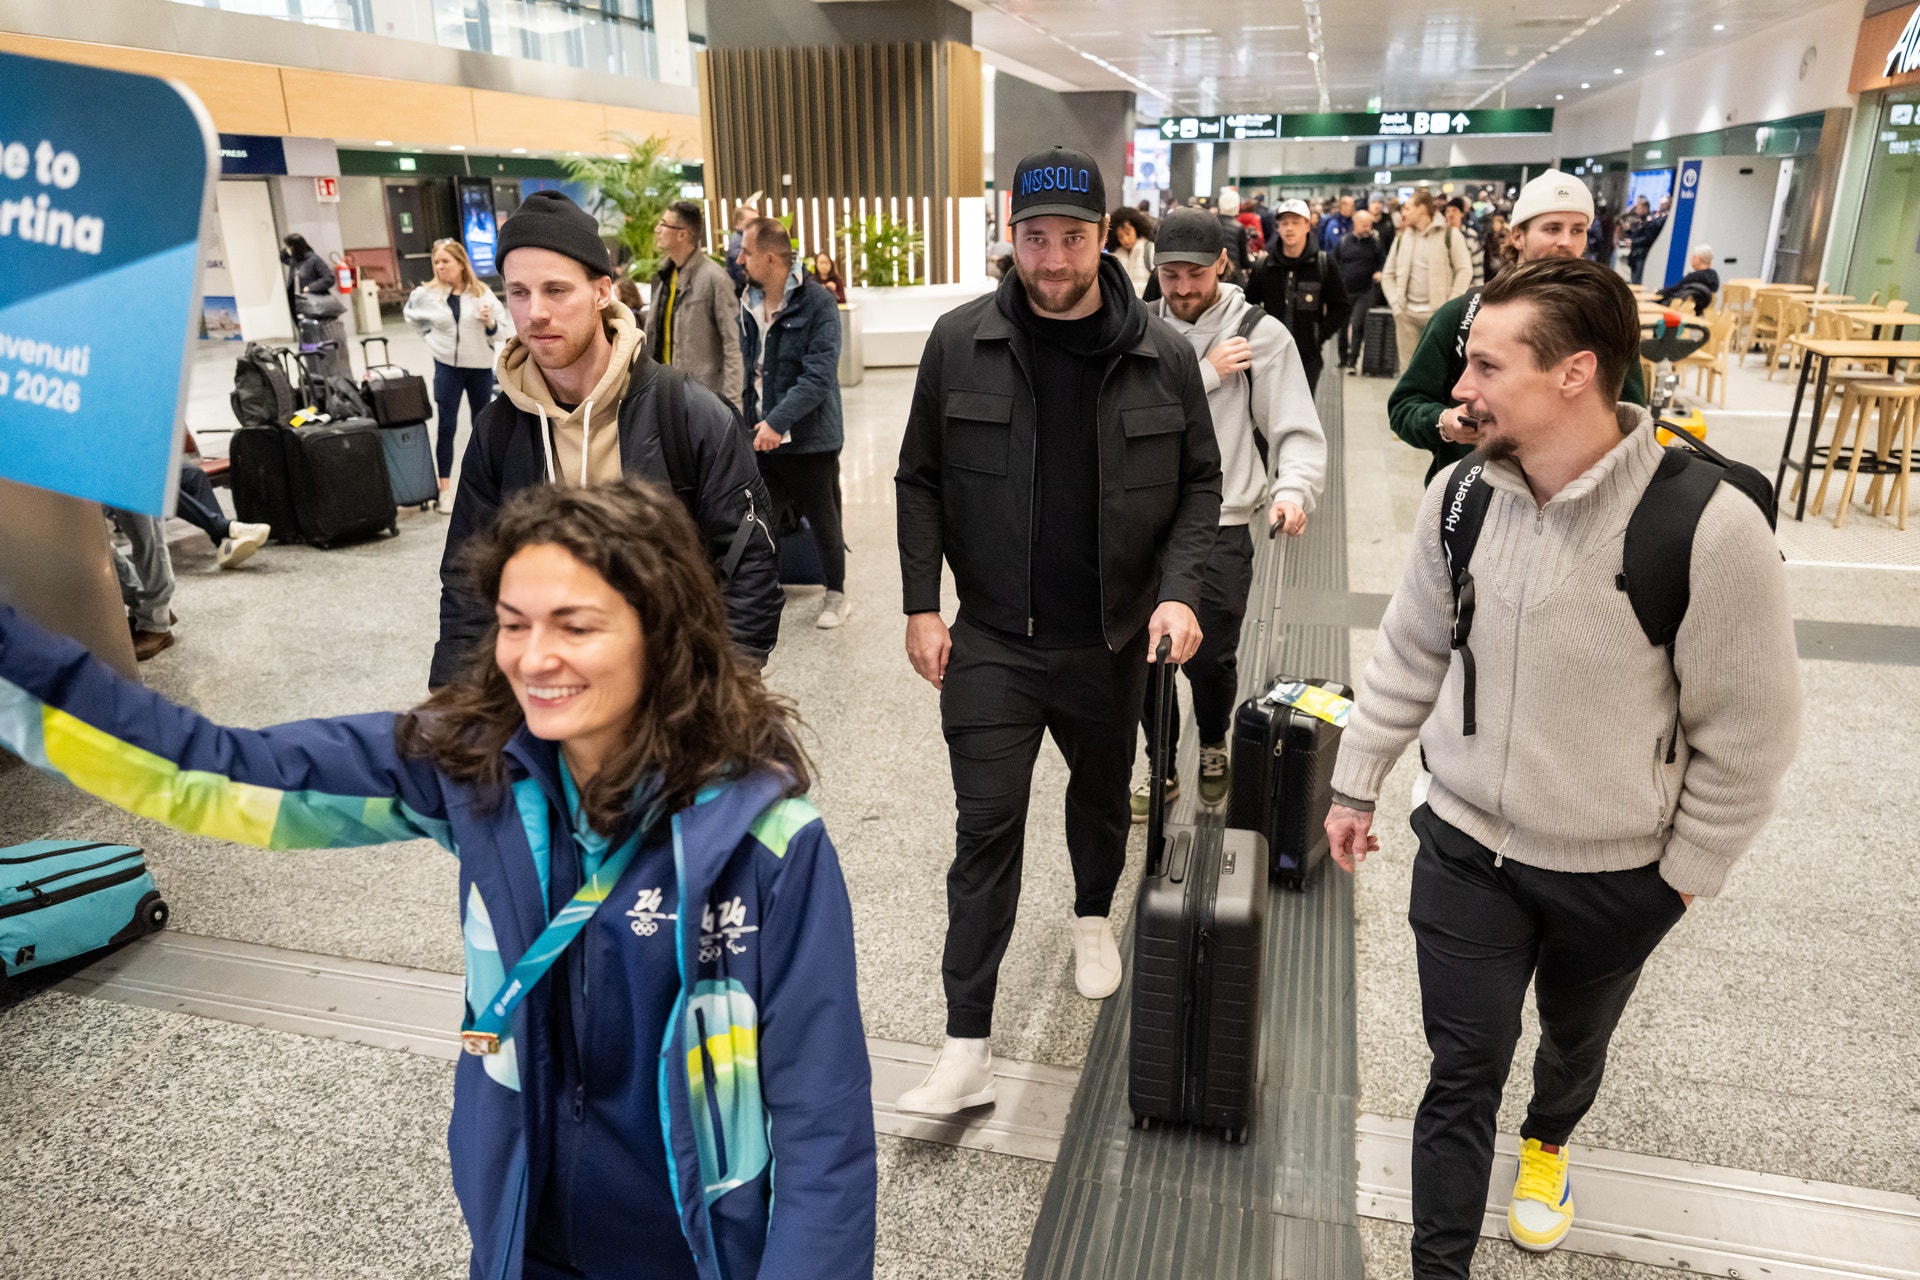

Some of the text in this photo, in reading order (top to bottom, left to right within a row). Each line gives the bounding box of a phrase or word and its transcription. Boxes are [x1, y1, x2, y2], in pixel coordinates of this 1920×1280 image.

[35, 139, 81, 189] to
[14, 369, 81, 414] 2026
[1445, 465, 1482, 532] Hyperice
